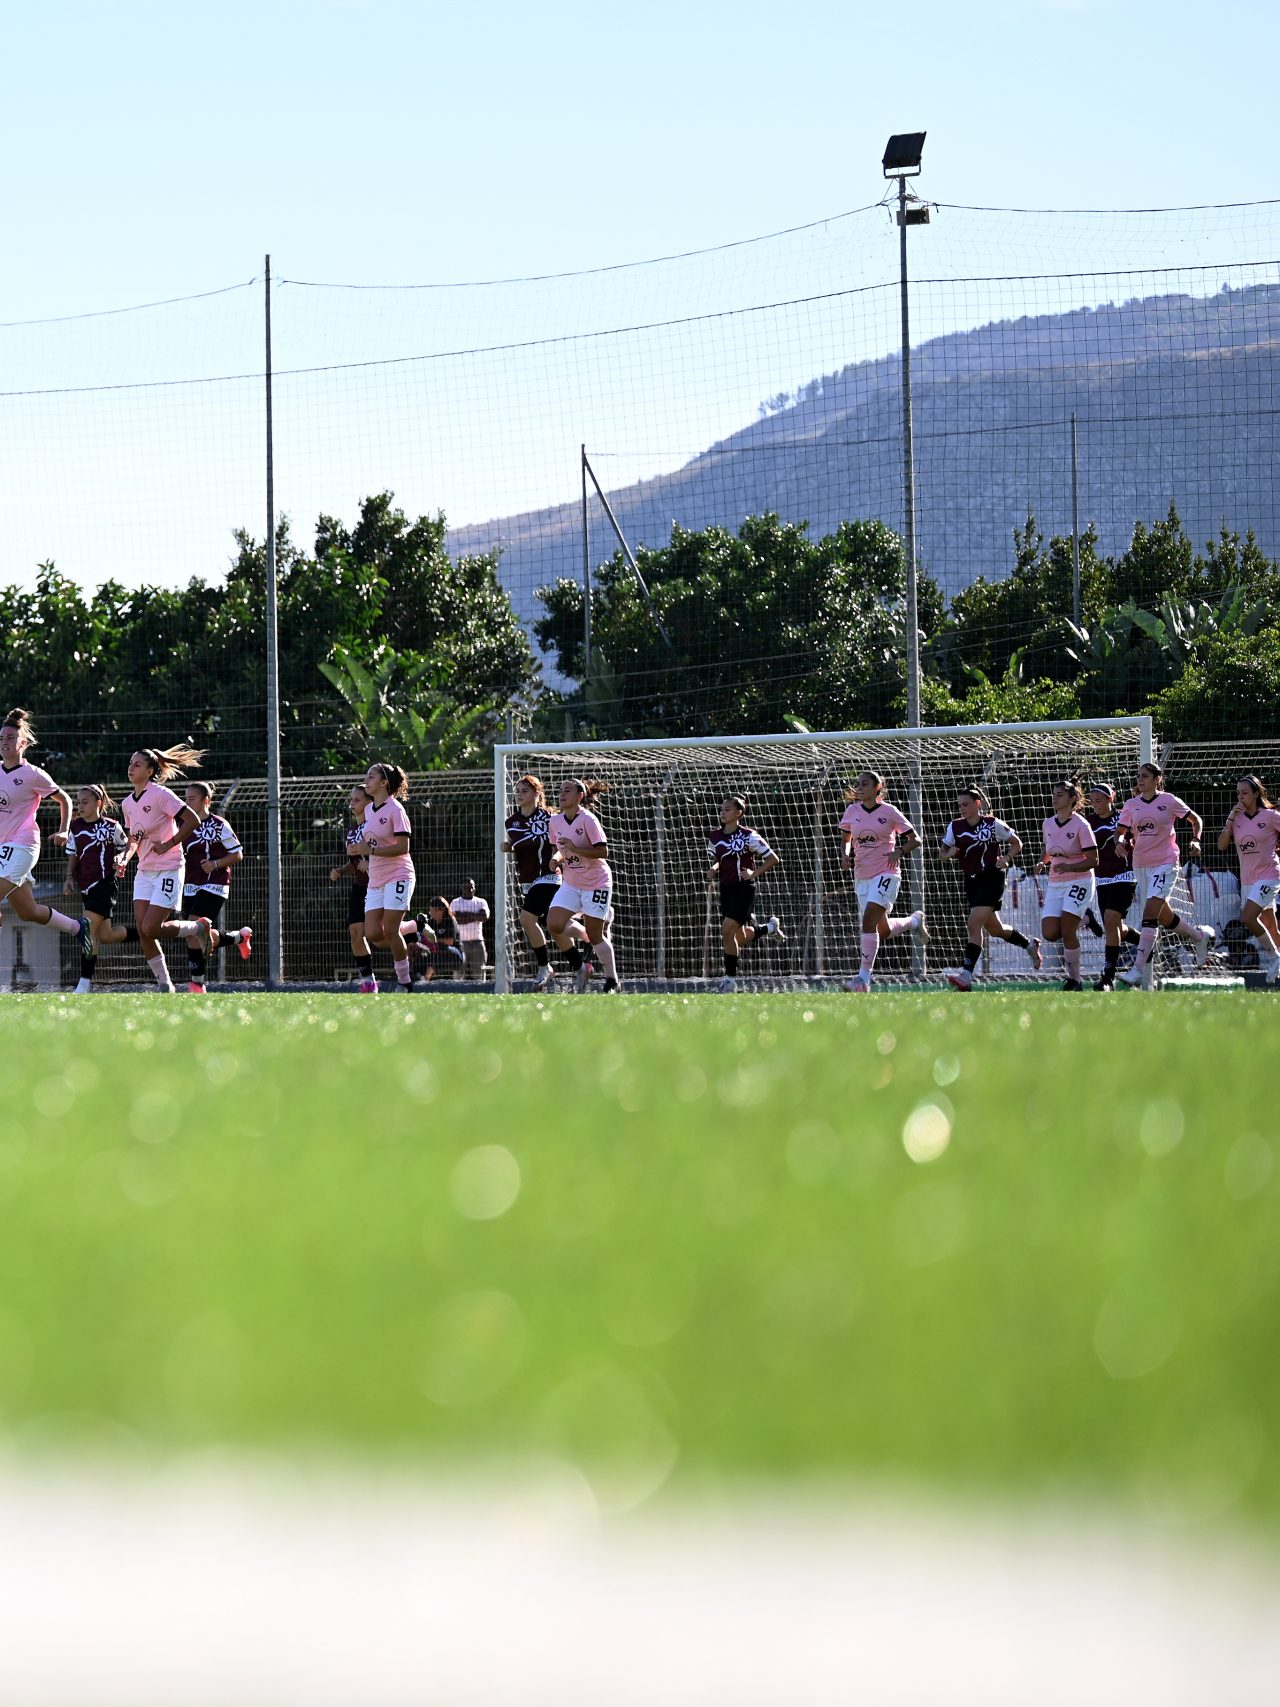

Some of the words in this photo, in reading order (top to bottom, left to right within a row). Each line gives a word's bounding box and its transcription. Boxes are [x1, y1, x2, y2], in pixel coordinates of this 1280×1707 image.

[0, 846, 14, 861] 31
[162, 878, 174, 893] 19
[396, 881, 405, 894] 6
[878, 876, 891, 891] 14
[1153, 874, 1166, 887] 74
[592, 889, 609, 904] 69
[1068, 885, 1087, 901] 28
